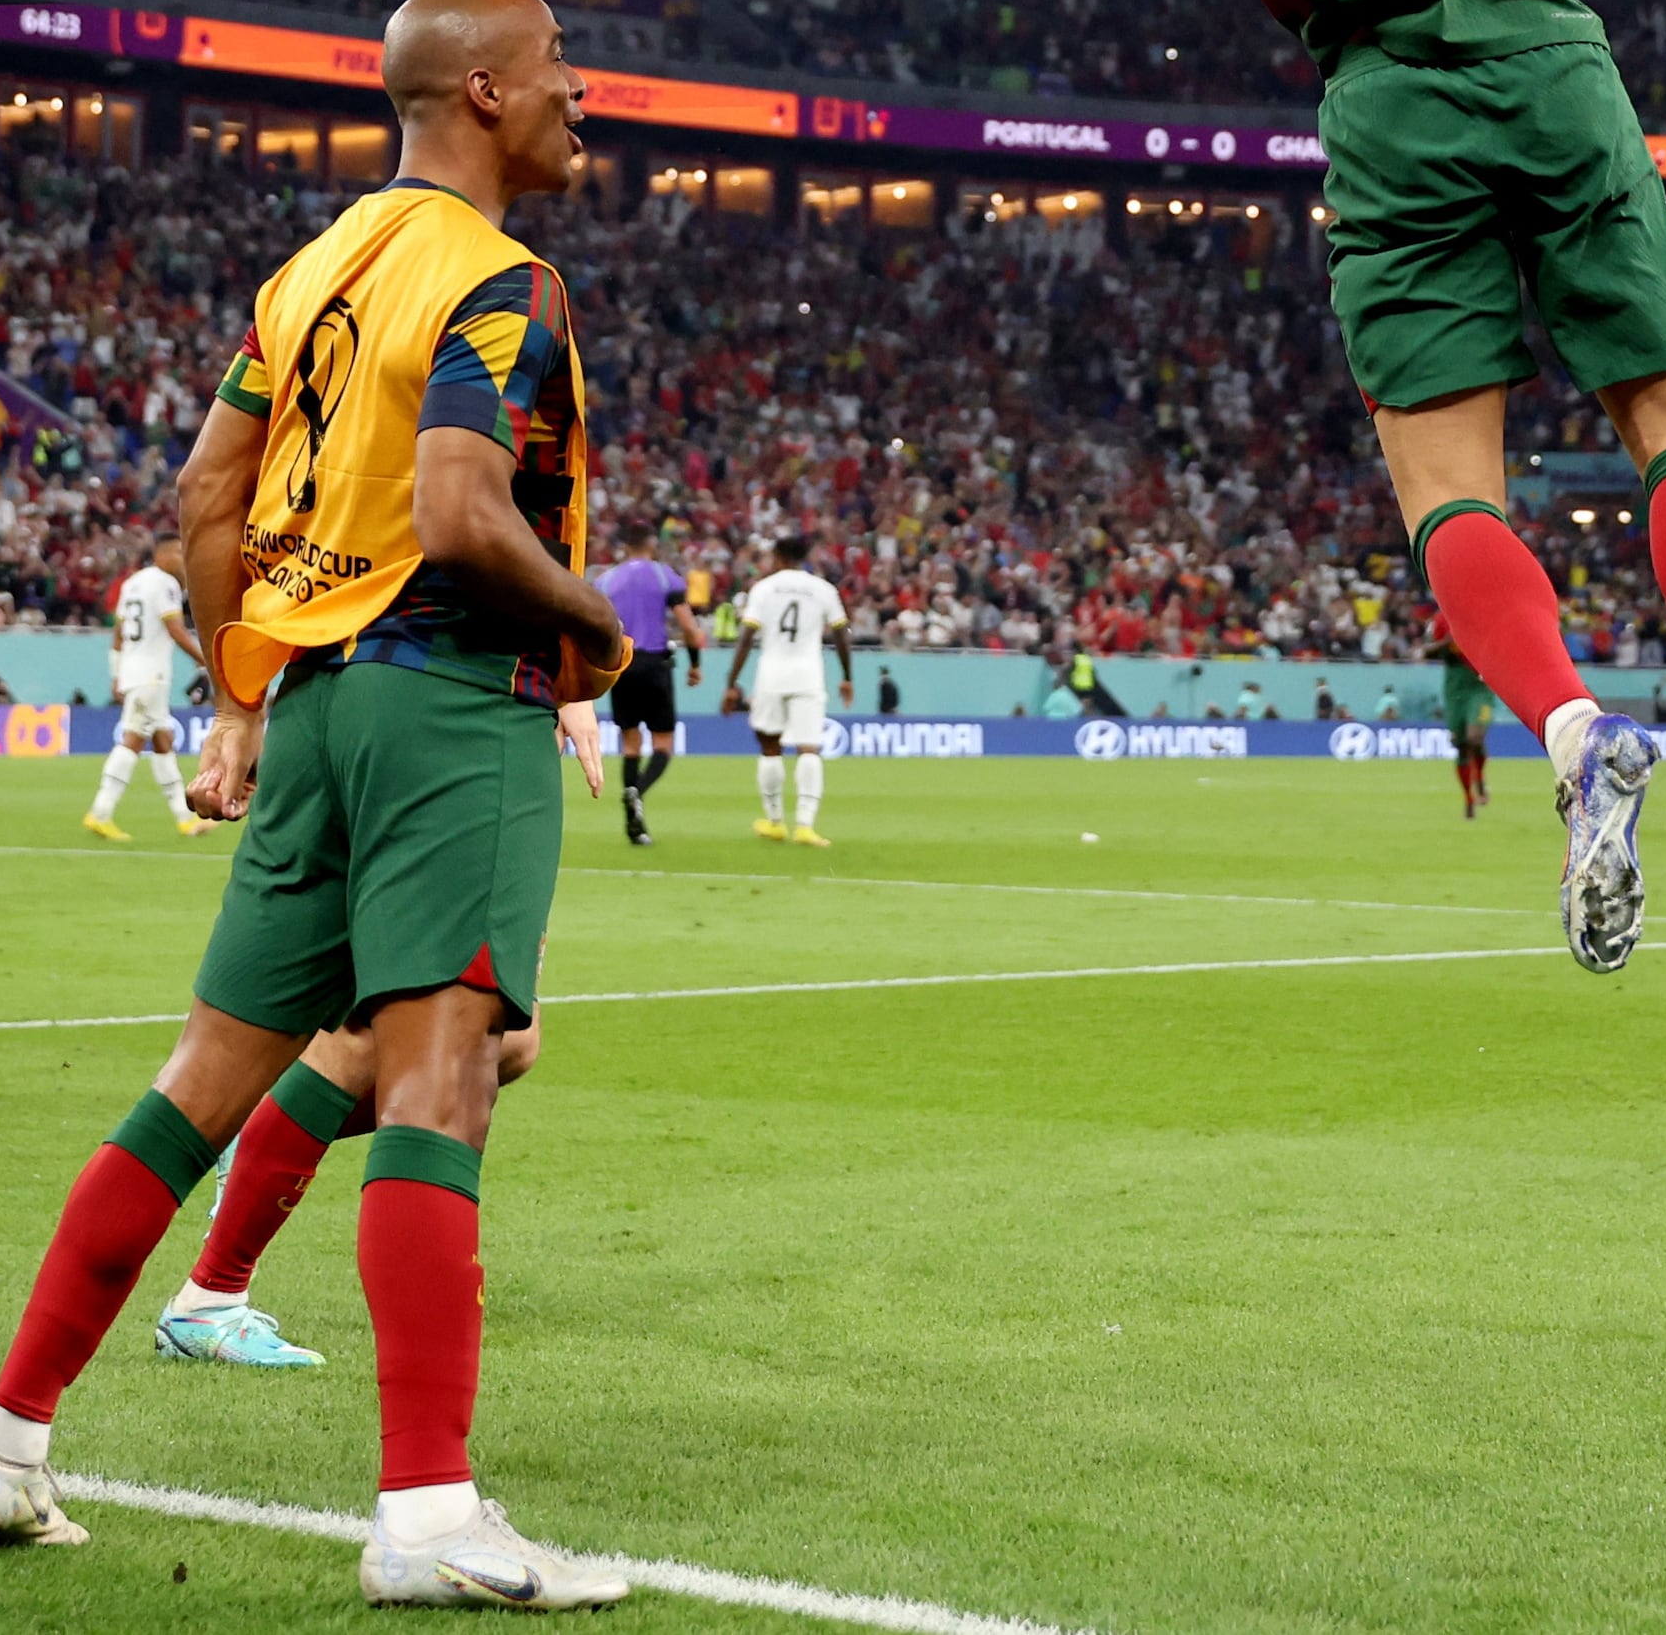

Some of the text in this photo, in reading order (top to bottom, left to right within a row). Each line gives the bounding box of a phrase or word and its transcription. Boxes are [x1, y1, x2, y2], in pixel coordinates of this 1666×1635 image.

[20, 8, 81, 40] 64:23
[983, 119, 1111, 152] PORTUGAL
[1145, 127, 1170, 158] 0
[1211, 131, 1236, 161] 0
[1266, 135, 1328, 162] GHA
[259, 529, 320, 568] WORLD
[319, 550, 373, 579] CUP
[780, 600, 799, 642] 4
[851, 722, 984, 755] HYUNDAI
[1130, 724, 1246, 758] HYUNDAI
